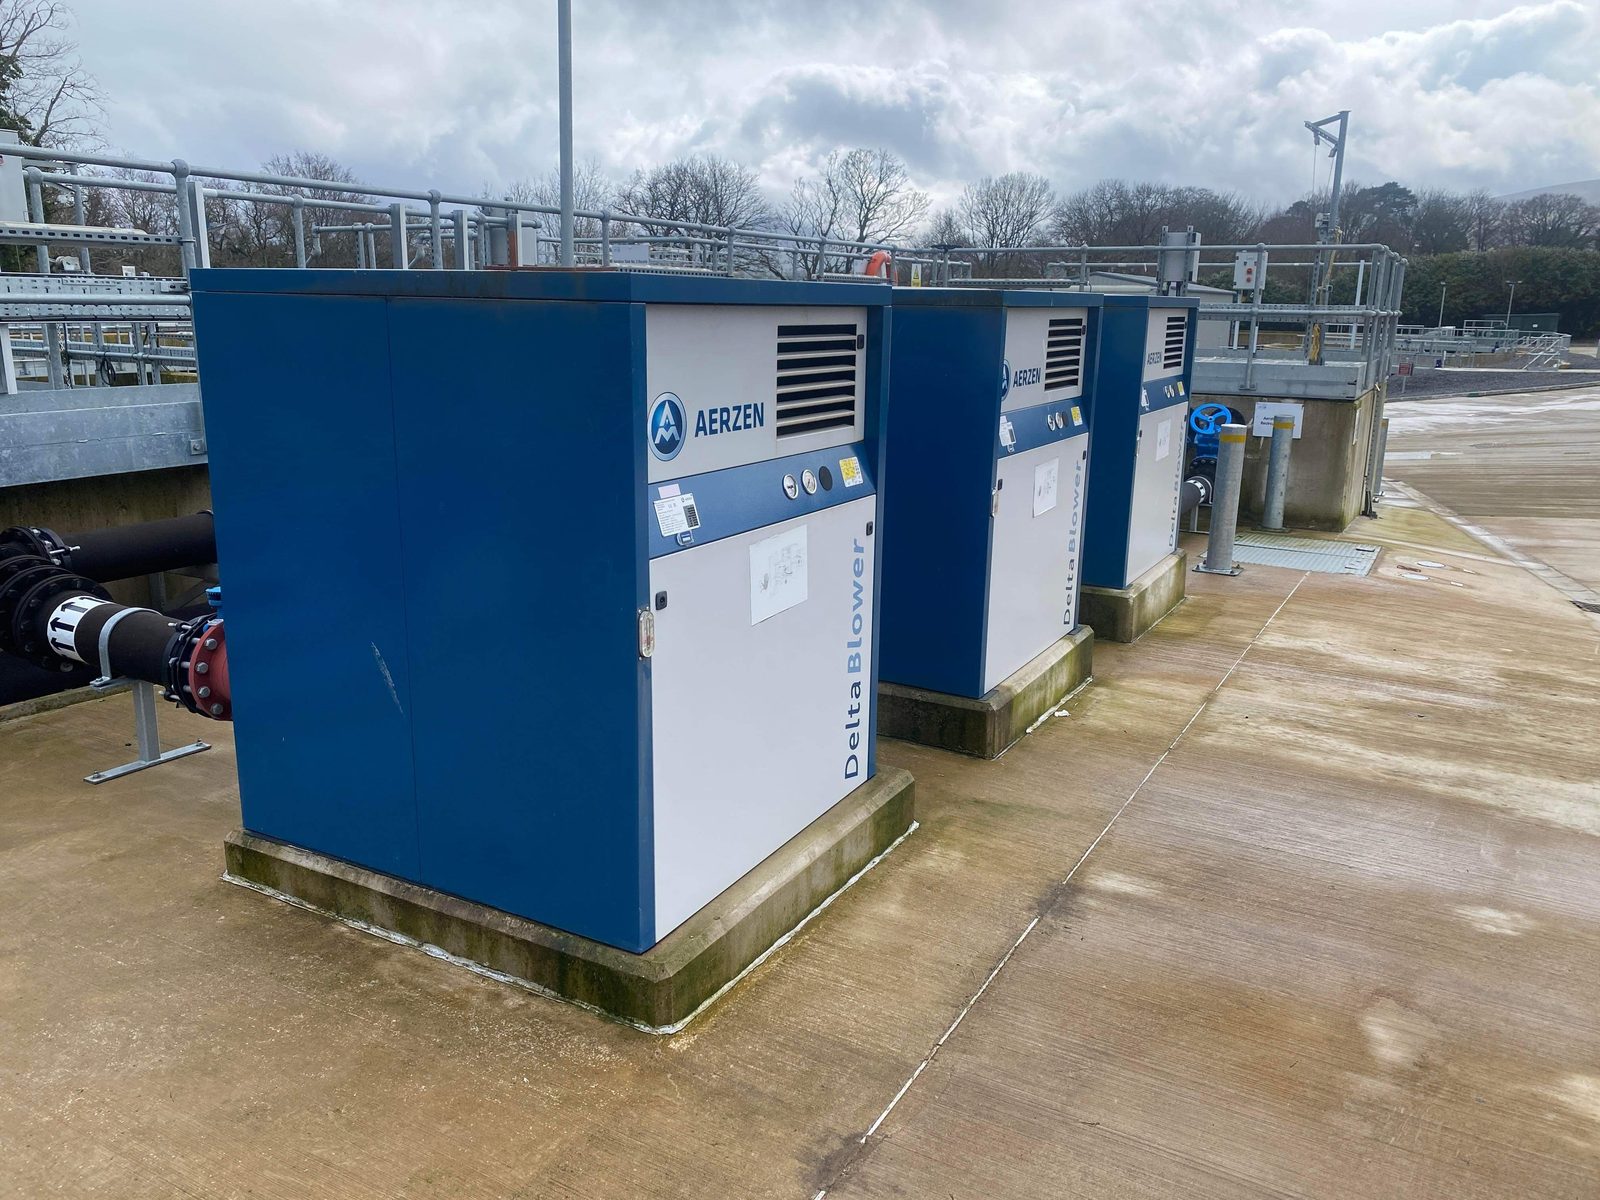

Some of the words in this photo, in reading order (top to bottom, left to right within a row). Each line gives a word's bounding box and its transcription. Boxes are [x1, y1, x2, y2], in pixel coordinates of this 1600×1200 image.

[1013, 368, 1041, 387] AERZEN
[1147, 351, 1161, 365] AERZEN
[694, 402, 765, 438] AERZEN
[1068, 459, 1082, 553] Blower
[847, 538, 865, 674] Blower
[1063, 558, 1075, 625] Delta
[844, 681, 861, 780] Delta
